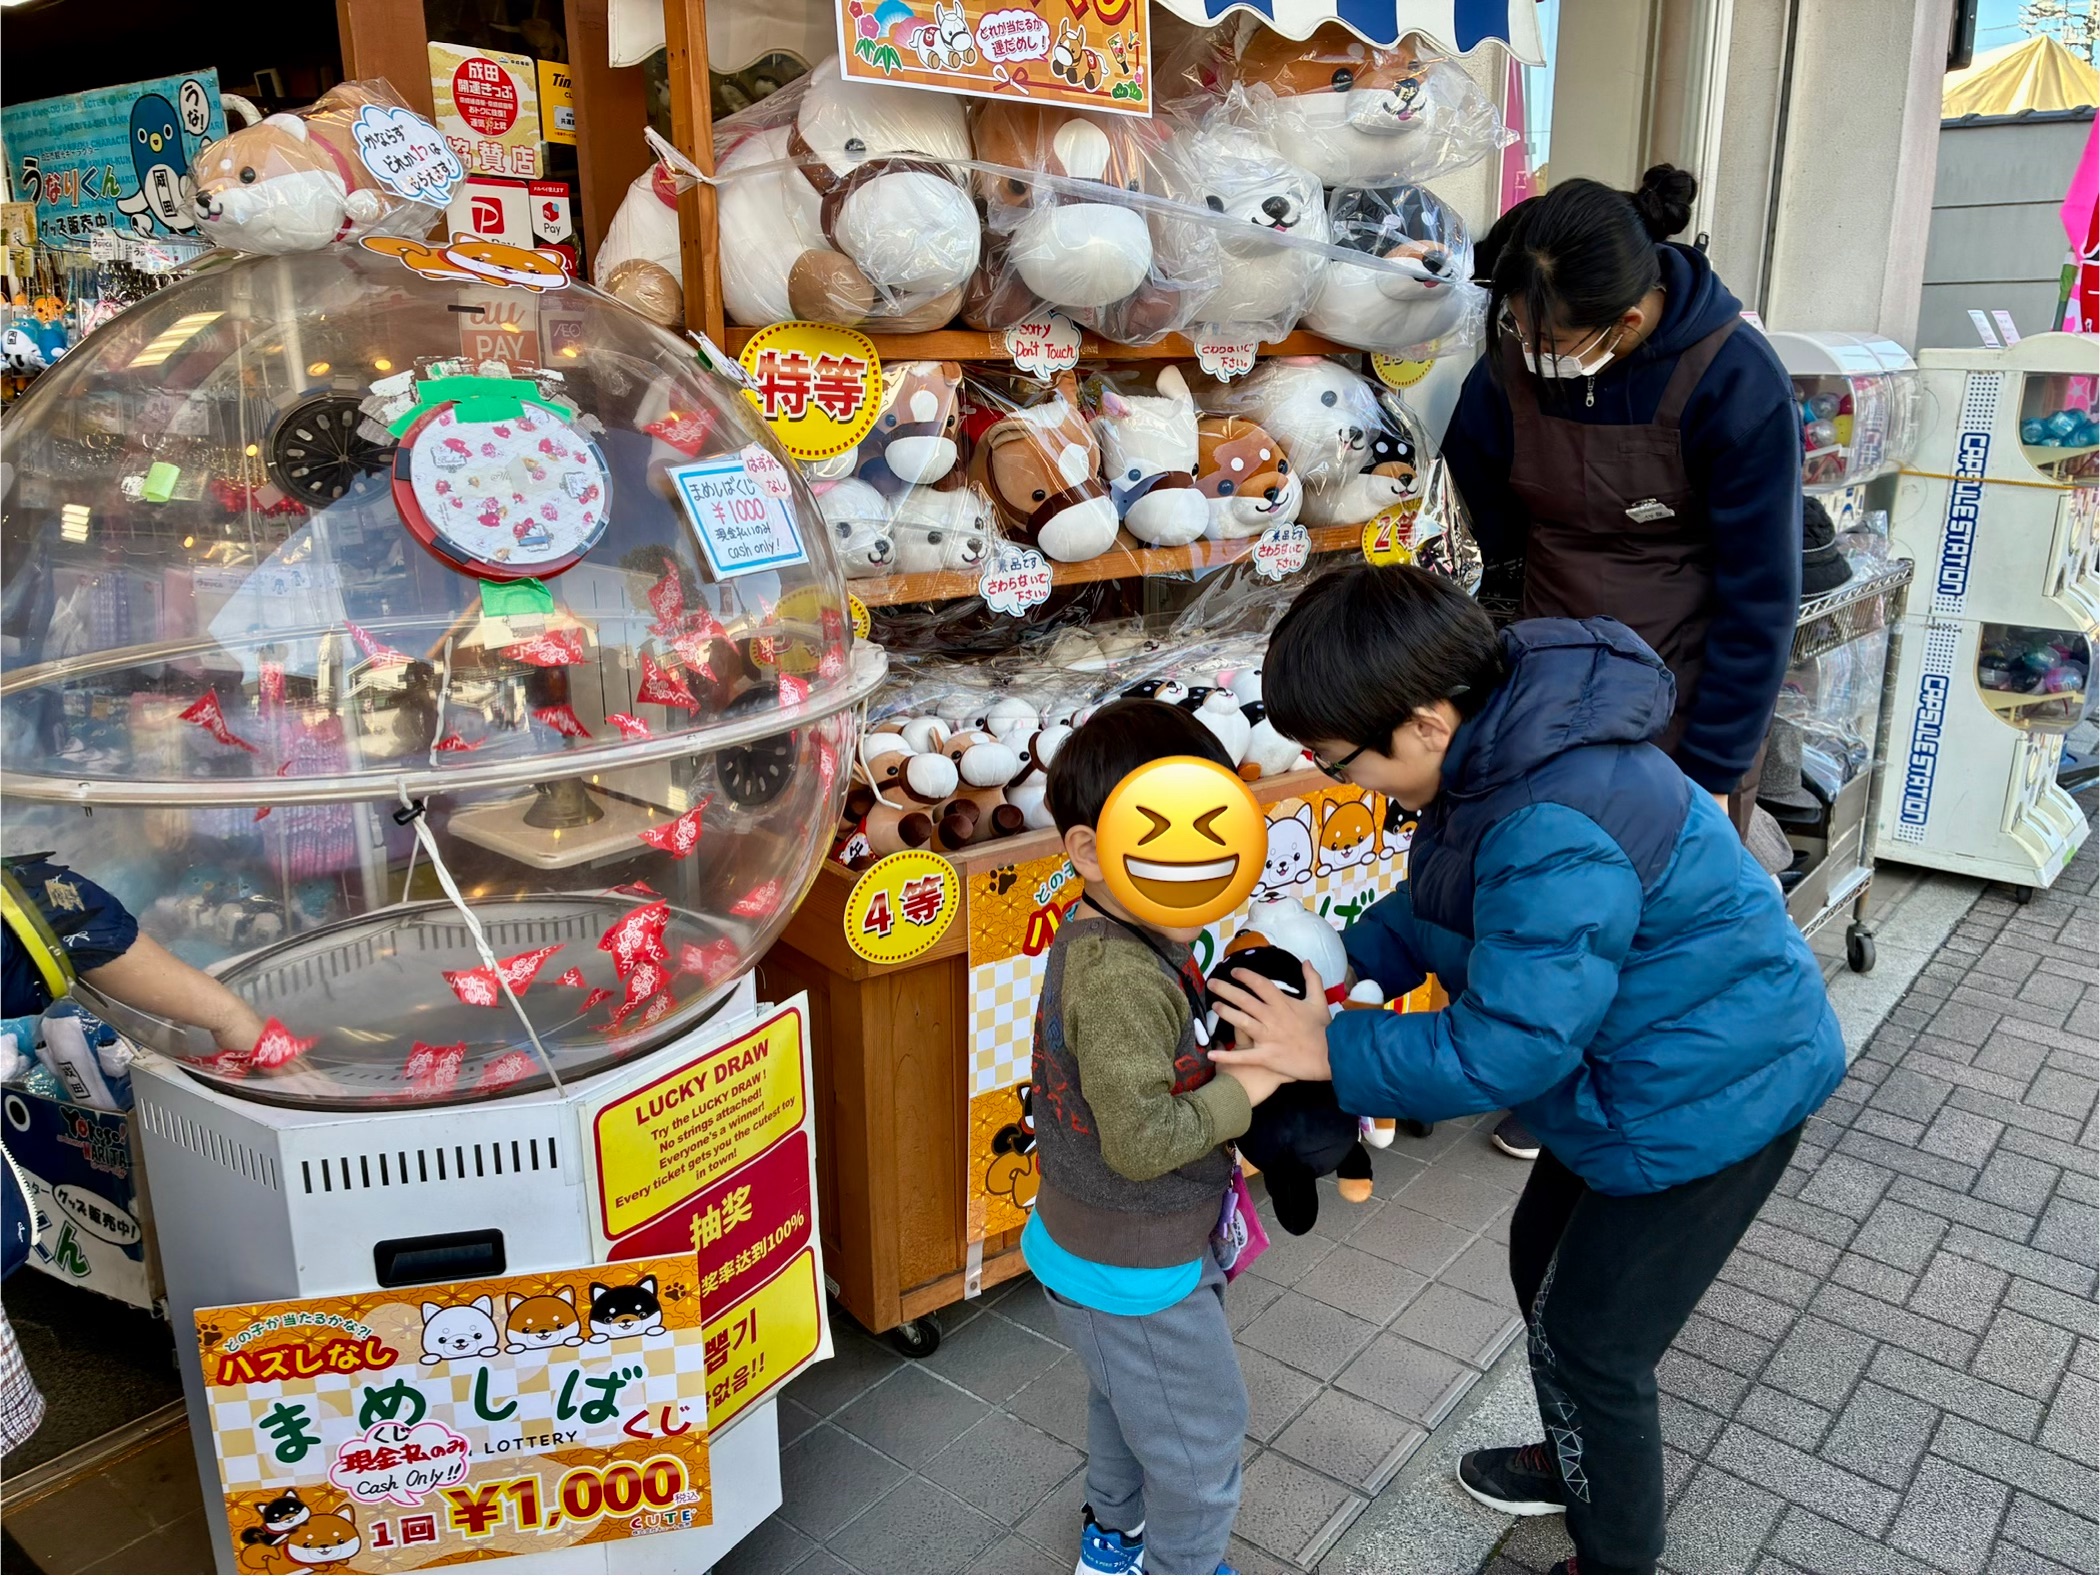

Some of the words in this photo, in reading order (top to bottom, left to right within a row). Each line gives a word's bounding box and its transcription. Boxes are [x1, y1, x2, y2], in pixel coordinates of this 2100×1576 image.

[980, 18, 1043, 40] どれが当たるか
[468, 62, 499, 82] 成田
[457, 79, 513, 99] 開運きっぷ
[364, 125, 405, 149] かならず
[446, 136, 535, 175] 協賛店
[22, 156, 122, 207] うなりくん
[543, 222, 561, 236] Pay
[475, 334, 525, 361] PAY
[1015, 340, 1040, 358] Don't
[1044, 343, 1075, 360] Touch
[757, 349, 868, 421] 特等
[747, 454, 780, 473] はずれ
[689, 475, 757, 502] まめしばくじ
[765, 479, 787, 493] なし
[711, 498, 766, 524] ¥1000
[714, 523, 772, 543] 現金払いのみ
[1257, 542, 1305, 558] さわらないで
[987, 573, 1048, 593] さわらないで
[863, 876, 945, 936] 4等
[635, 1073, 708, 1126] LUCKY
[714, 1039, 770, 1084] DRAW
[651, 1126, 669, 1142] Try
[672, 1115, 690, 1130] the
[692, 1091, 729, 1119] LUCKY
[659, 1138, 675, 1153] No
[677, 1119, 714, 1146] strings
[715, 1088, 762, 1122] attached!
[659, 1130, 718, 1170] Everyone's
[720, 1126, 727, 1135] a
[728, 1101, 765, 1130] winner!
[615, 1185, 651, 1208] Every
[653, 1162, 686, 1189] ticket
[688, 1150, 712, 1171] gets
[713, 1140, 732, 1161] you
[734, 1128, 750, 1143] the
[752, 1106, 781, 1131] cutest
[782, 1095, 796, 1114] toy
[696, 1168, 706, 1181] in
[708, 1148, 738, 1175] town!
[57, 1188, 137, 1239] グッズ販売中!
[689, 1183, 753, 1251] 抽奖
[701, 1210, 805, 1298] 奖率达到100%
[223, 1311, 373, 1352] どの子が当たるかな?!
[220, 1339, 394, 1383] ハズしなし
[374, 1426, 411, 1443] くじ
[623, 1405, 692, 1439] くじ
[485, 1430, 578, 1454] LOTTERY
[357, 1474, 399, 1495] Cash
[447, 1459, 686, 1535] ¥1,000
[674, 1492, 699, 1504] 税込
[370, 1514, 436, 1548] 1回
[630, 1509, 695, 1530] CUTE
